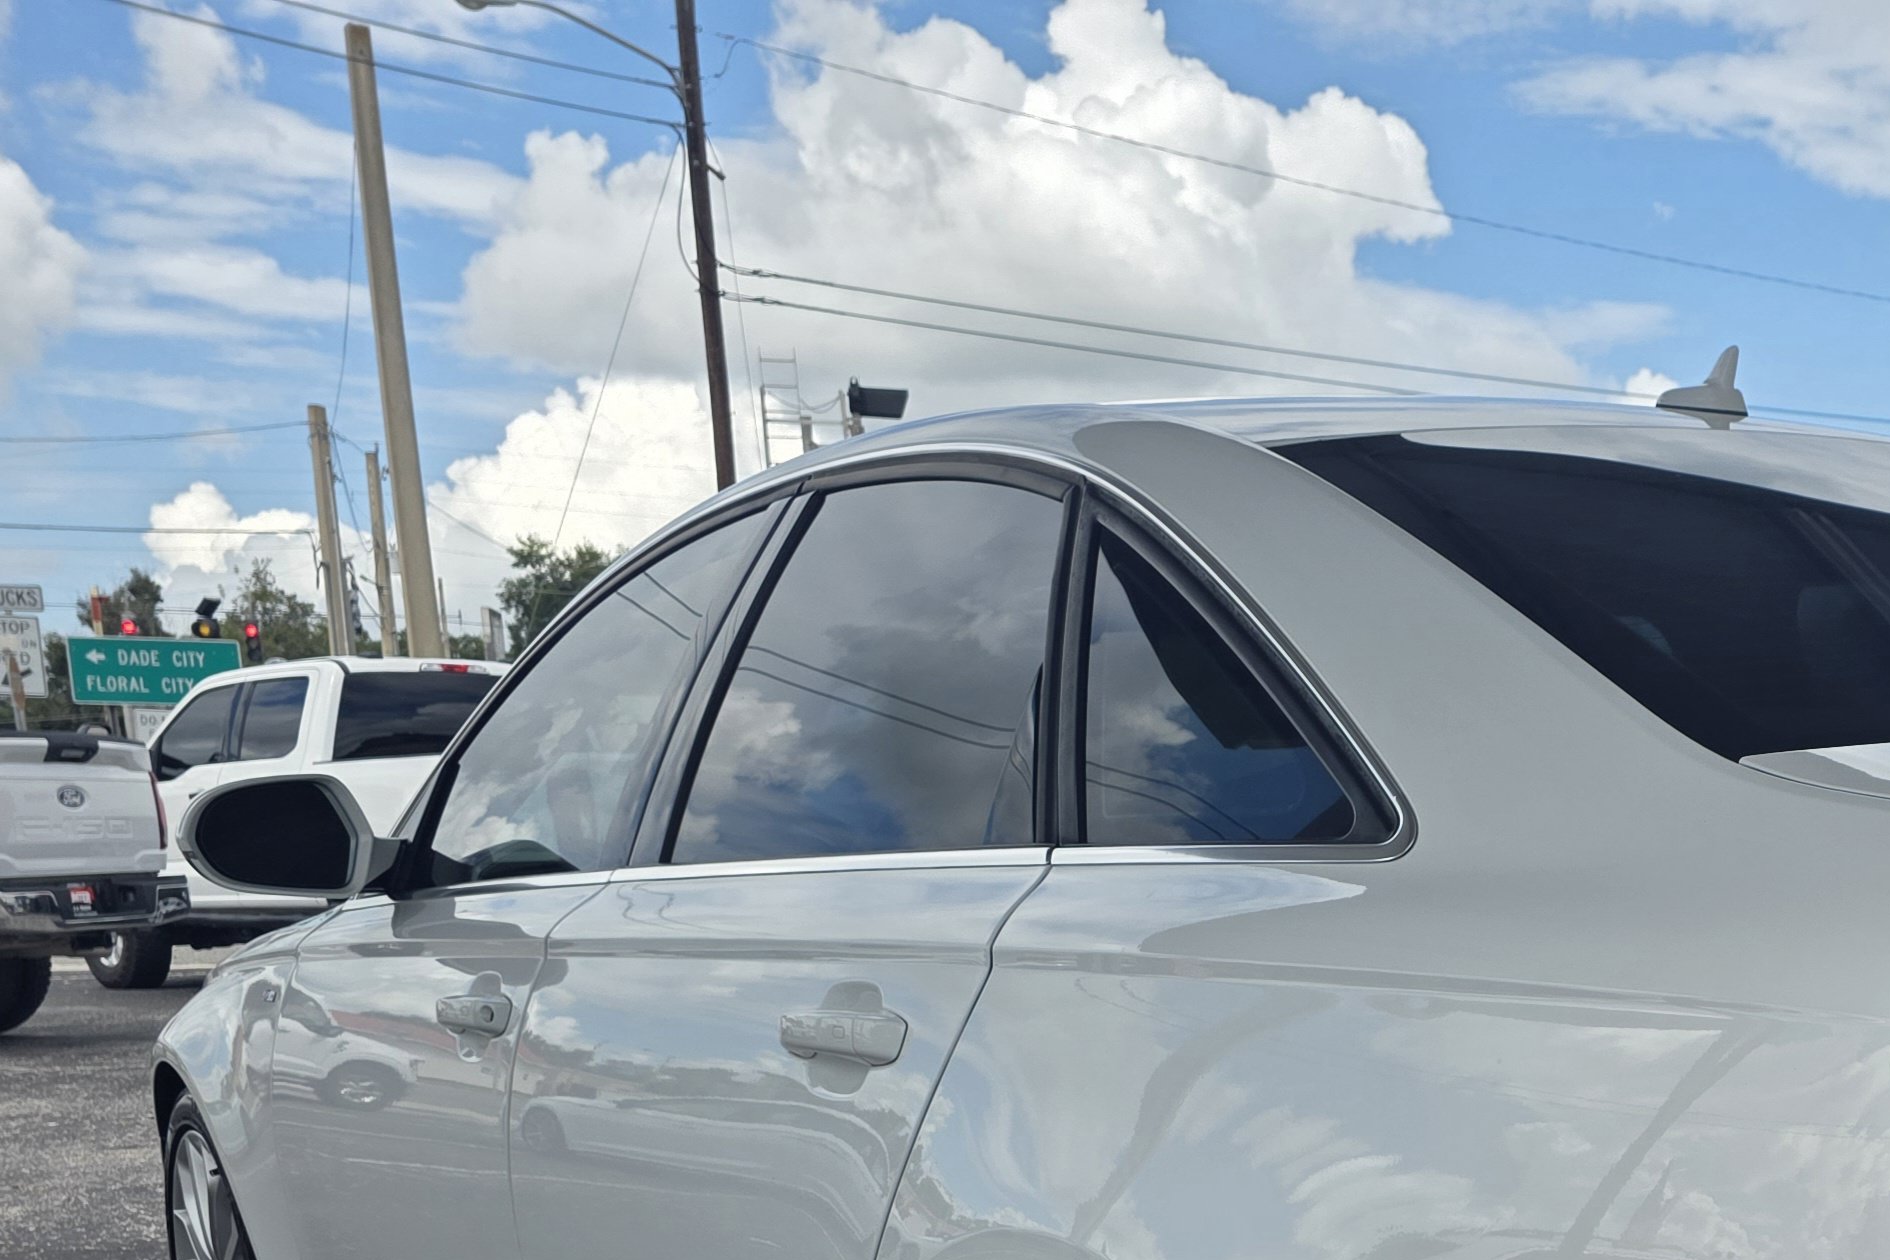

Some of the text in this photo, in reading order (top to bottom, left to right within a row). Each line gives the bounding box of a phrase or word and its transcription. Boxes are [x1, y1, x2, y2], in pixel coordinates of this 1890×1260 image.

[117, 649, 206, 668] DADE CITY
[86, 675, 195, 694] FLORAL CITY
